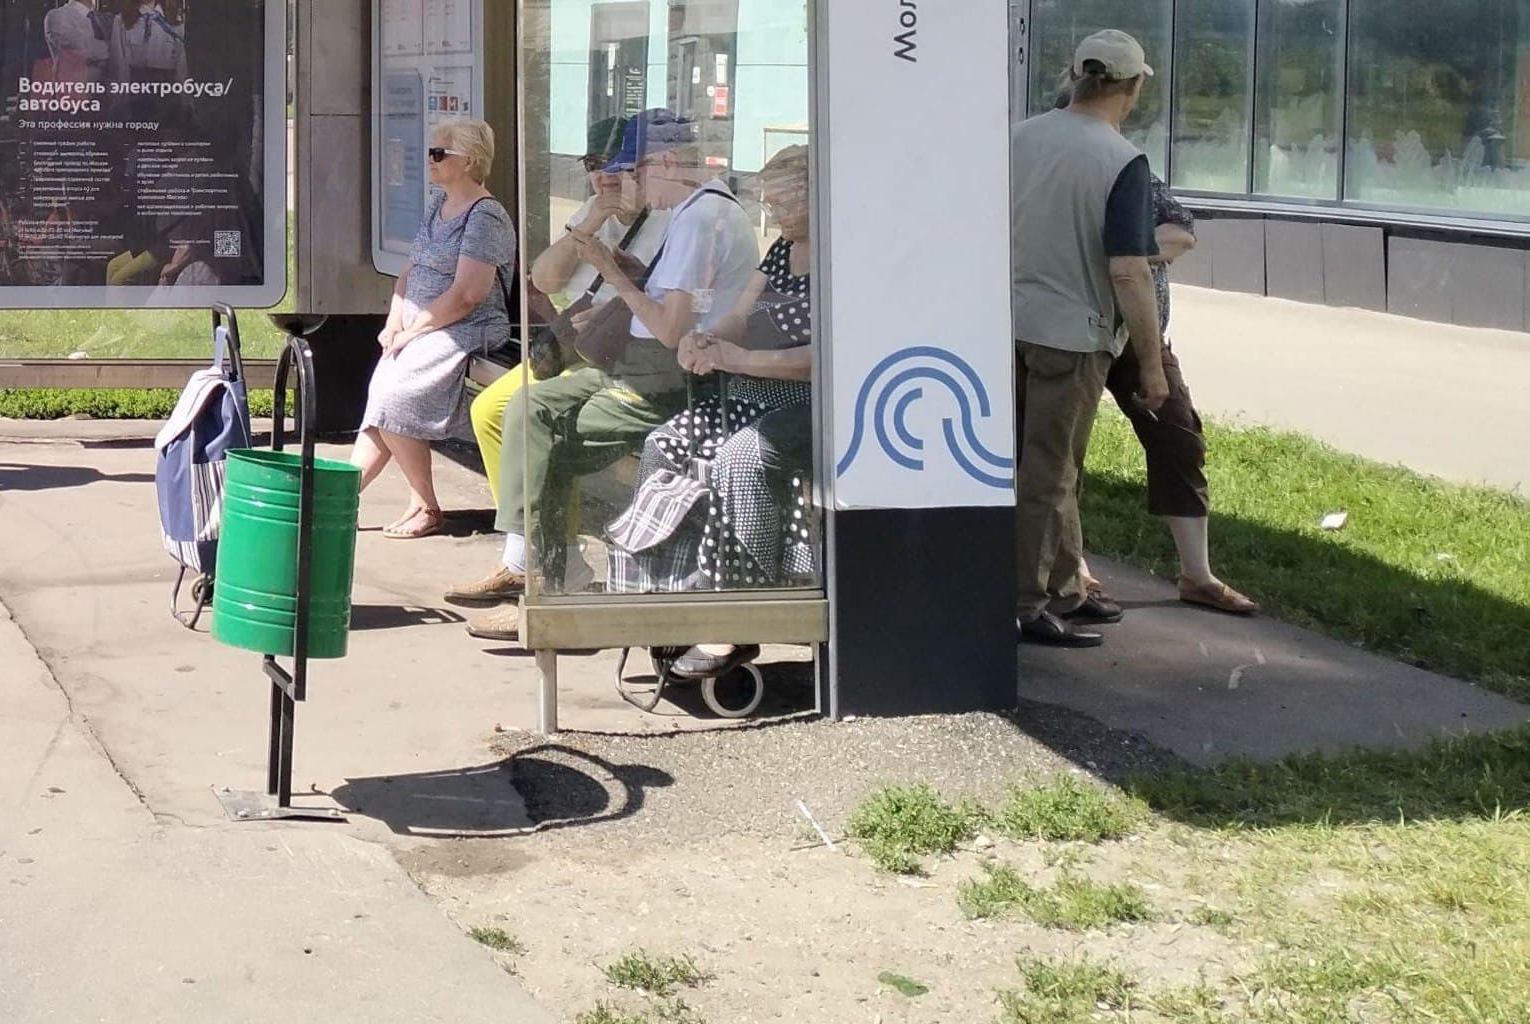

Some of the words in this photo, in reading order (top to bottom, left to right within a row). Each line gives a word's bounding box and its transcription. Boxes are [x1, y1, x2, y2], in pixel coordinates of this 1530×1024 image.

[18, 77, 105, 95] Водитель
[110, 77, 234, 97] электробуса/
[18, 96, 101, 114] автобуса
[18, 119, 36, 129] Эта
[37, 119, 91, 131] профессия
[93, 120, 123, 130] нужна
[125, 120, 159, 131] городу
